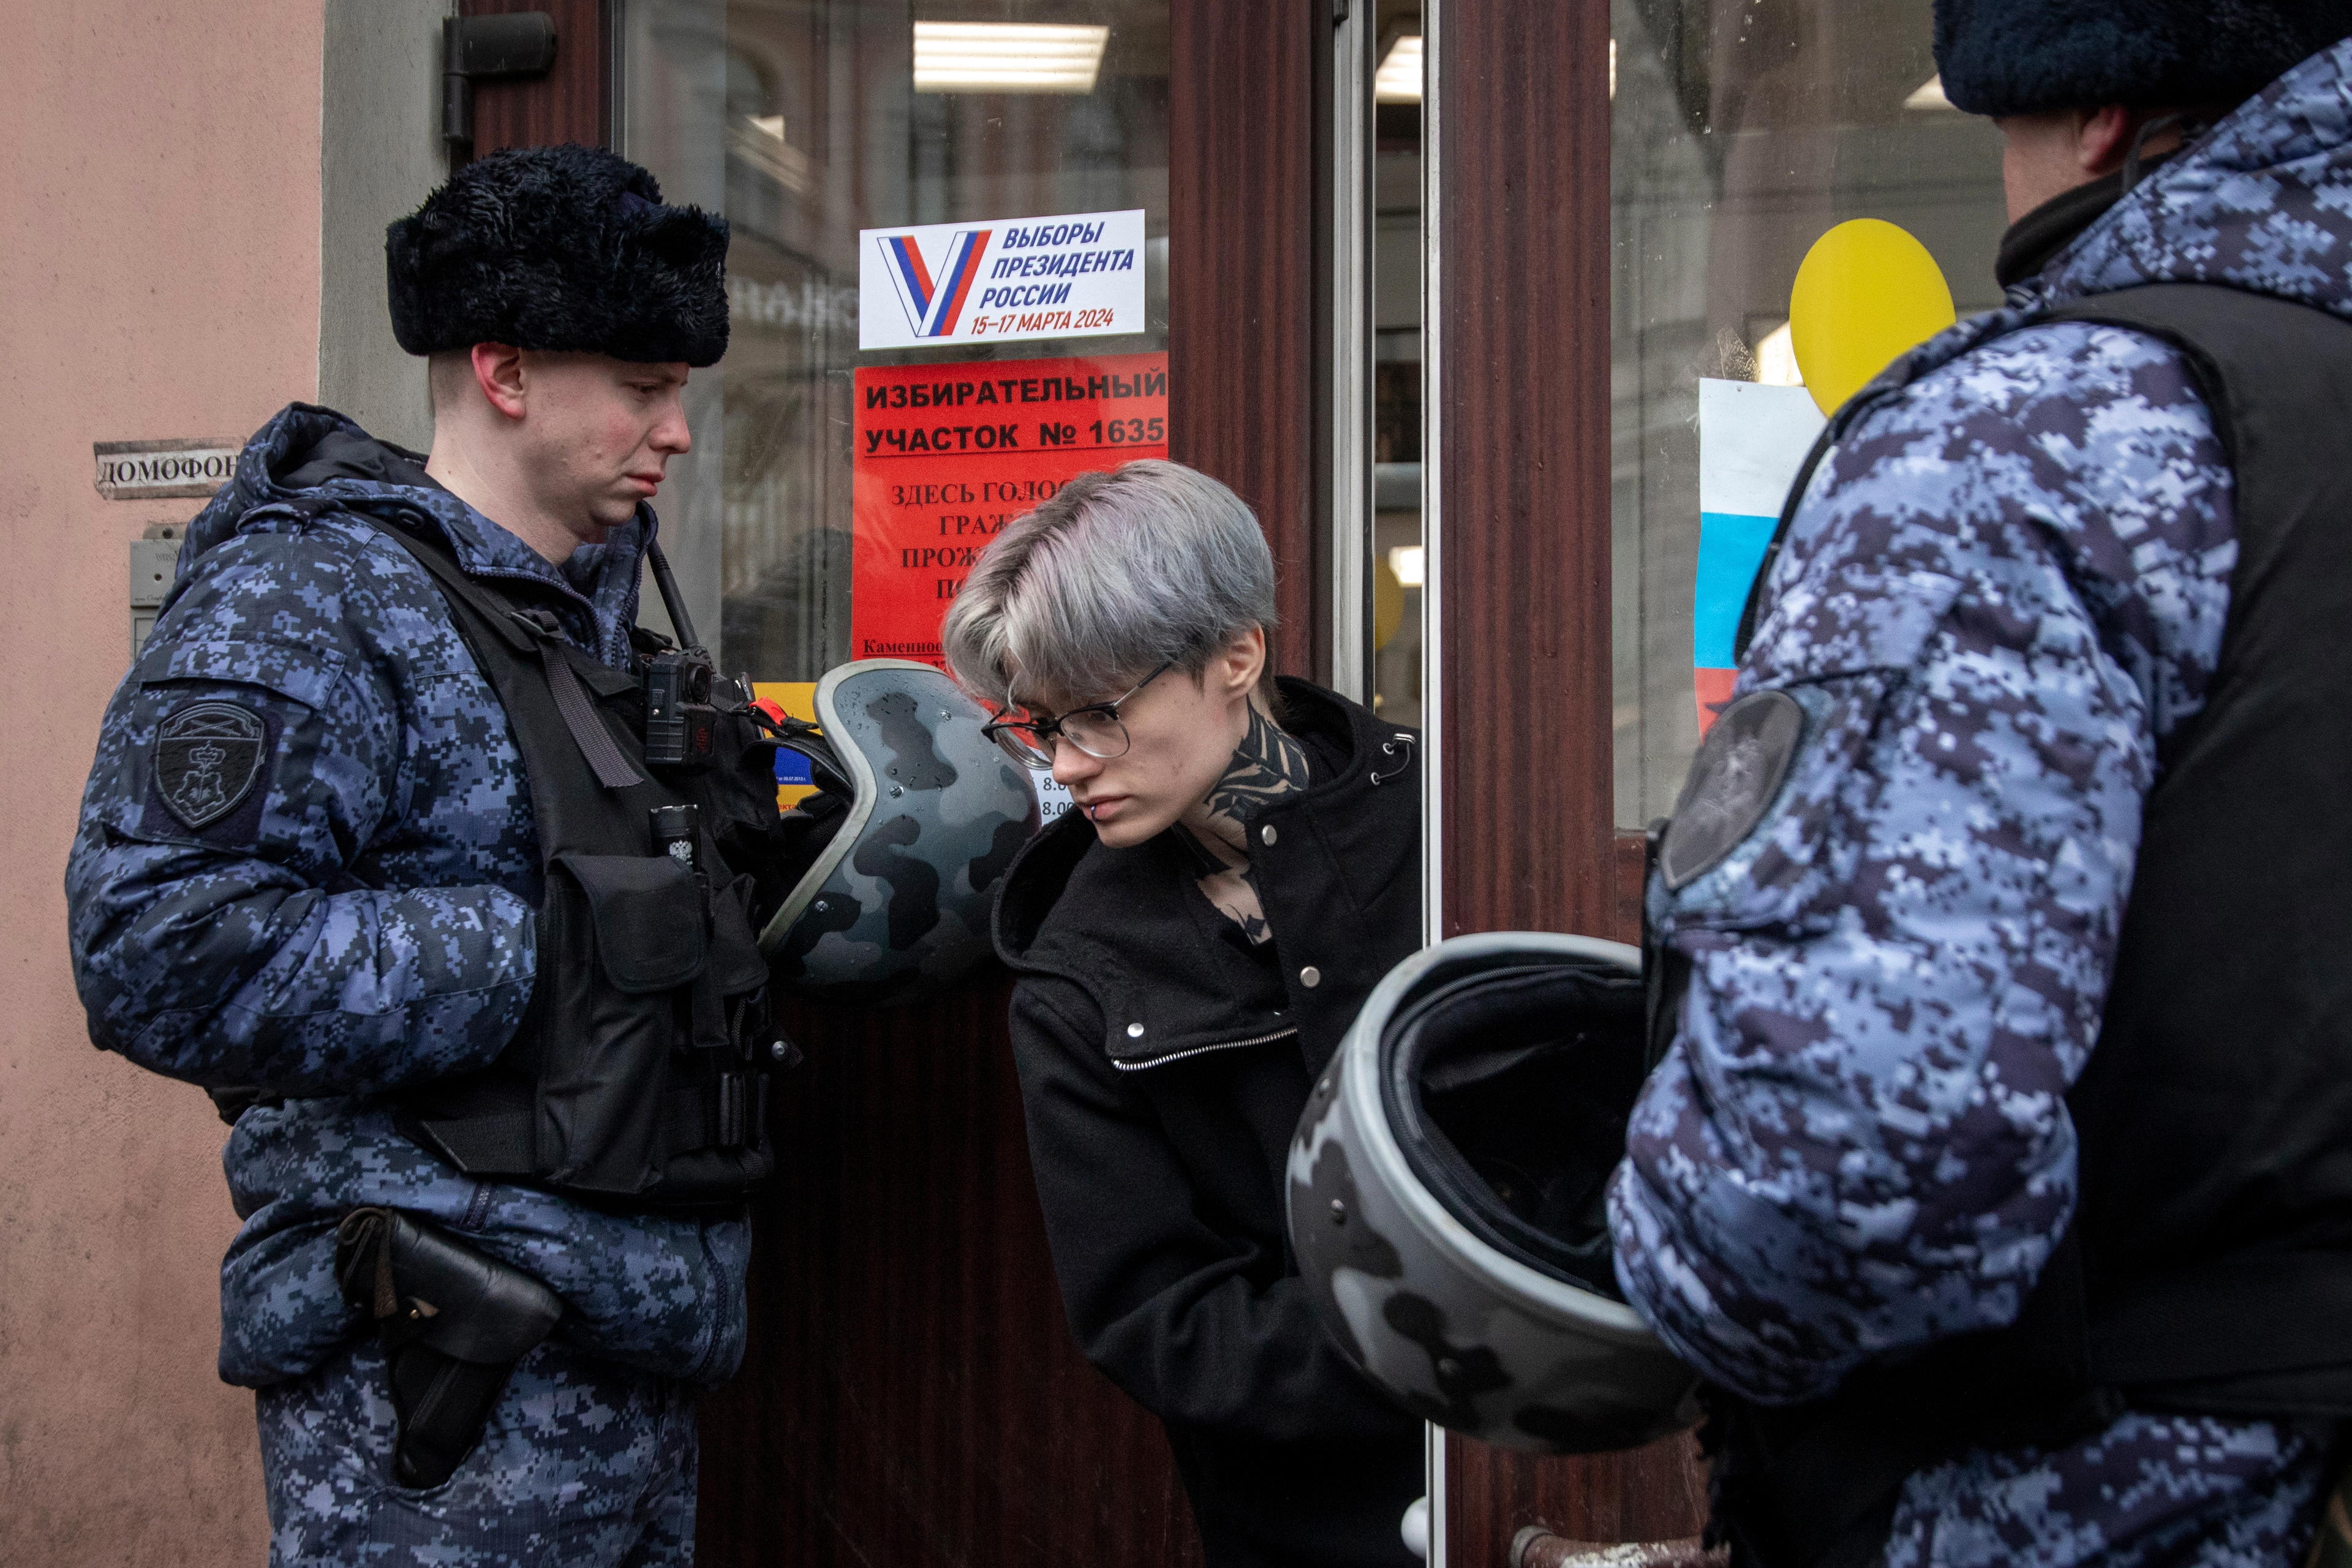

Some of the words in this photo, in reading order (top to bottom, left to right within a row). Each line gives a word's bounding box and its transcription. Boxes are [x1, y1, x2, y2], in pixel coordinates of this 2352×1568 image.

[1002, 221, 1105, 249] ВЫБОРЫ
[990, 248, 1134, 279] ПРЕЗИДЕНТА
[979, 282, 1072, 309] РОССИИ
[1016, 311, 1072, 332] МАРТА
[1074, 307, 1114, 328] 2024
[865, 368, 1167, 410] ИЗБИРАТЕЛЬНЫЙ
[865, 423, 1018, 453] УЧАСТОК
[1040, 421, 1076, 444] №
[1089, 418, 1164, 443] 1635
[97, 454, 238, 487] ДОМОФОН
[891, 483, 975, 510] ЗДЕСЬ
